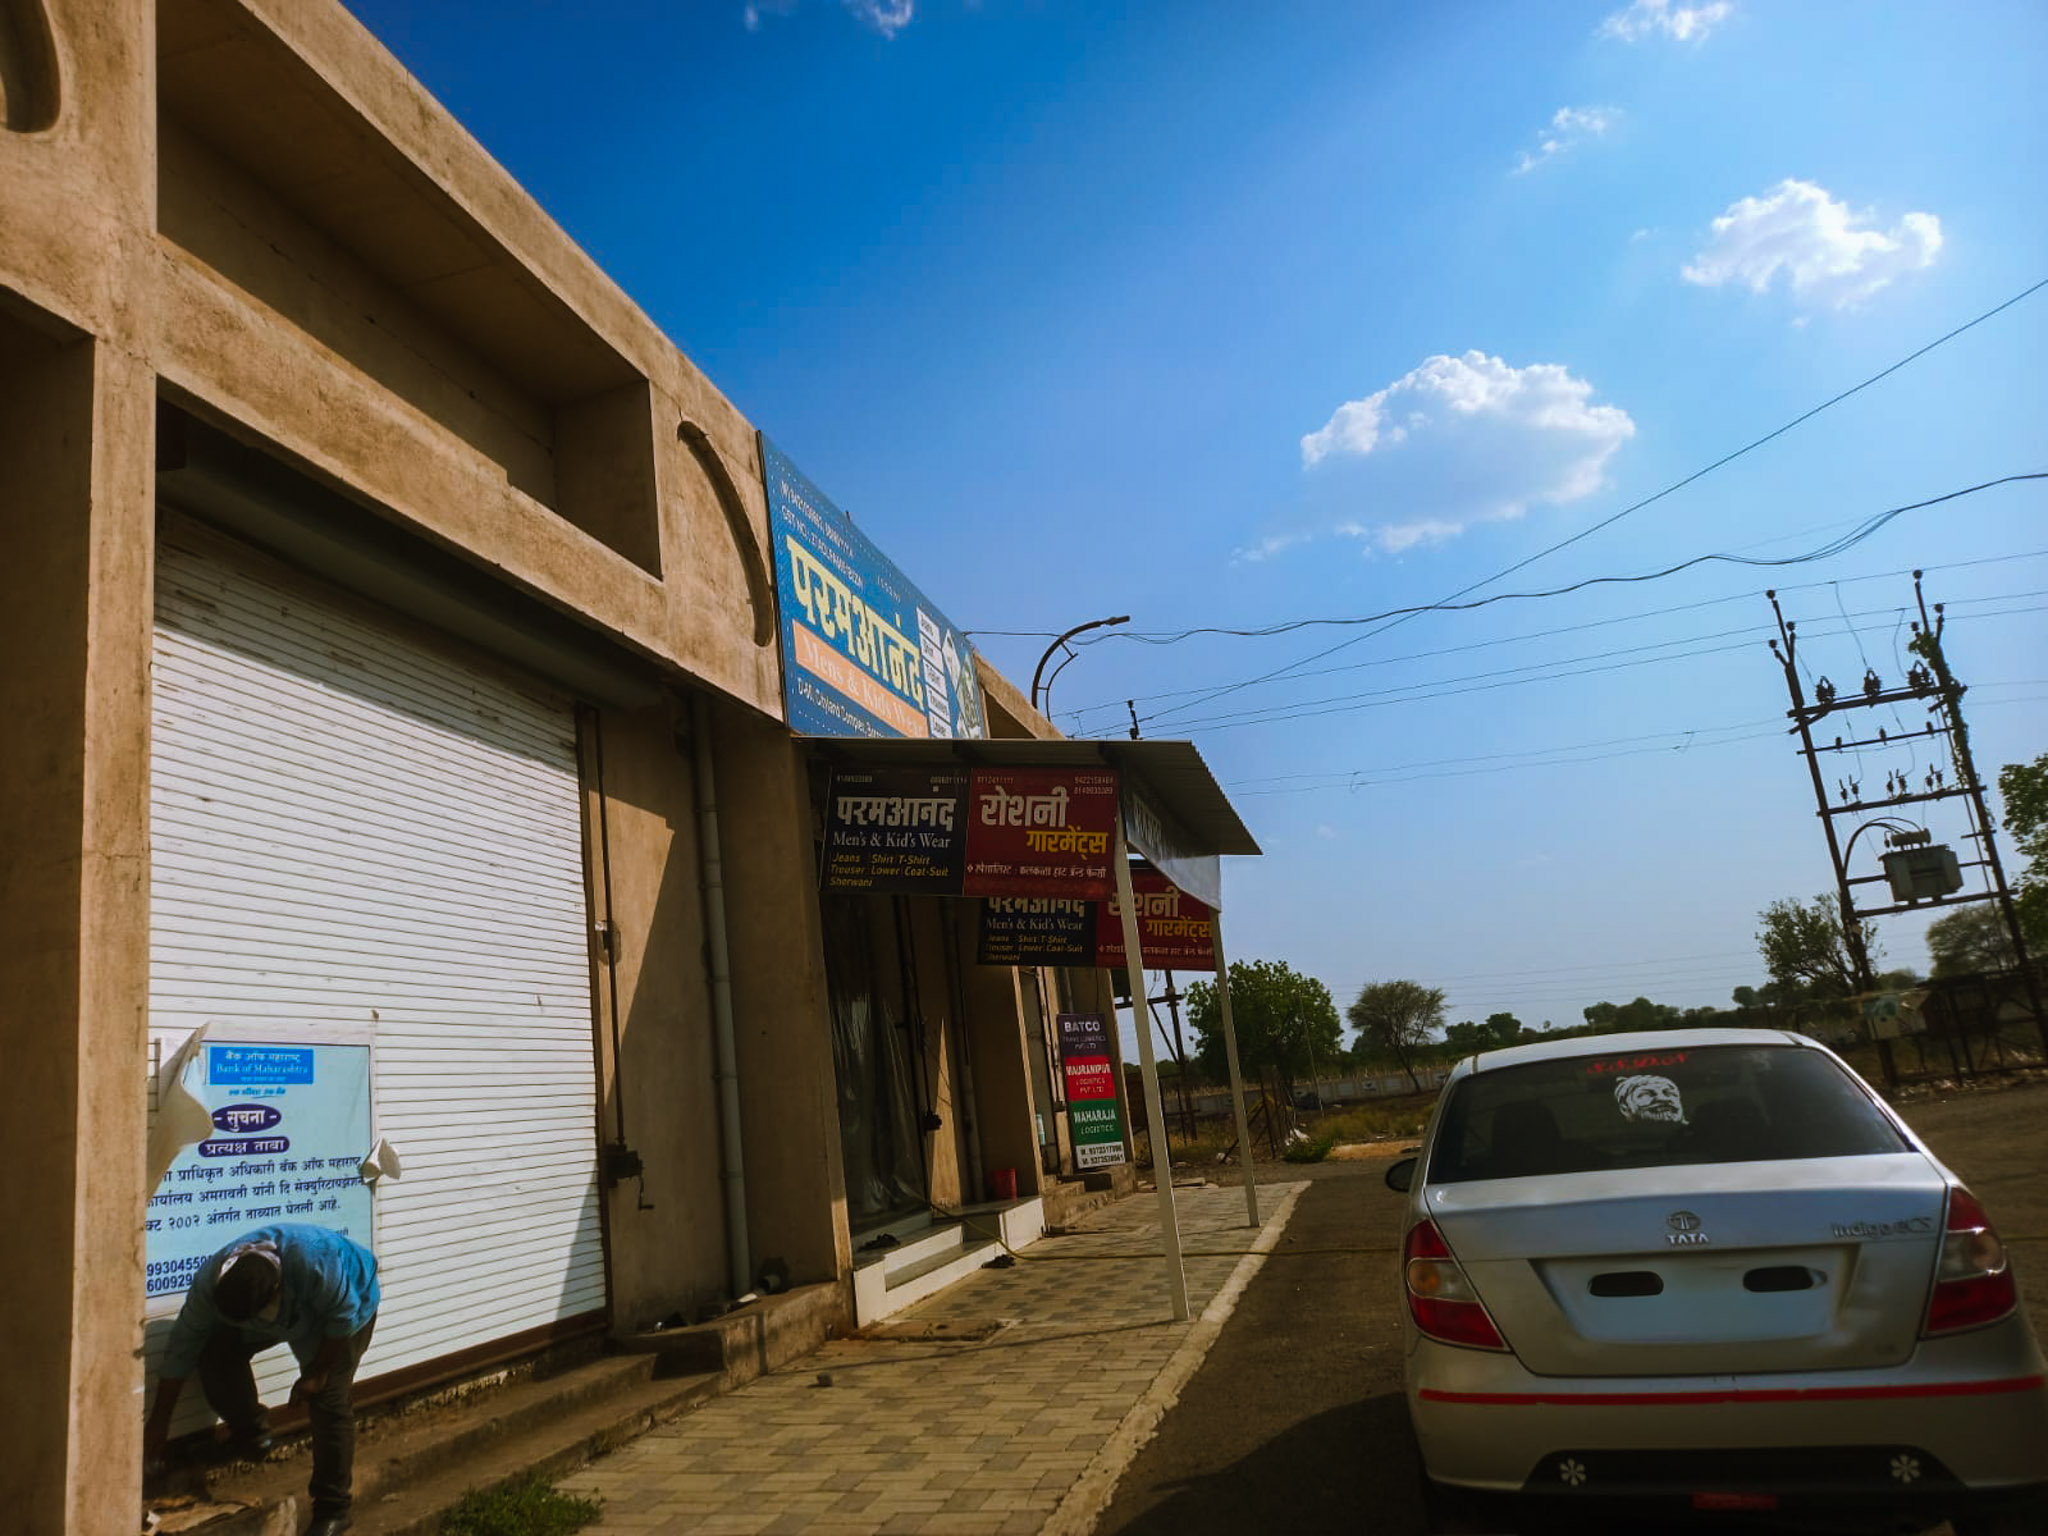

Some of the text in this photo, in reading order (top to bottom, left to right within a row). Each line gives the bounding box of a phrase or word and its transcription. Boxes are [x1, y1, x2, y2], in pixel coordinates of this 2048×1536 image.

[786, 533, 924, 712] परमआनंद
[836, 785, 958, 832] परमआनंद
[979, 784, 1071, 828] रोशनी
[832, 831, 953, 849] Men's & Kid's Wear
[1025, 825, 1109, 860] गारमेंट्स
[832, 852, 931, 866] Jeans Shirt T-Shirt
[872, 865, 901, 877] Lower
[985, 917, 1084, 932] Men's & Kid's Wear
[1064, 1020, 1101, 1033] BATCO
[216, 1062, 309, 1075] Bank of Maharashtra
[227, 1109, 267, 1132] सुचना
[1073, 1107, 1117, 1124] MAHARAJA
[206, 1139, 286, 1155] प्रत्यक्ष ताबा
[177, 1164, 225, 1184] प्राधिकृत
[230, 1160, 275, 1178] अधिकारी
[200, 1183, 249, 1203] अमरावती
[253, 1180, 275, 1197] यांनी
[207, 1206, 241, 1226] अंतर्गत
[246, 1206, 281, 1219] ताब्यात
[1667, 1233, 1710, 1245] TATA
